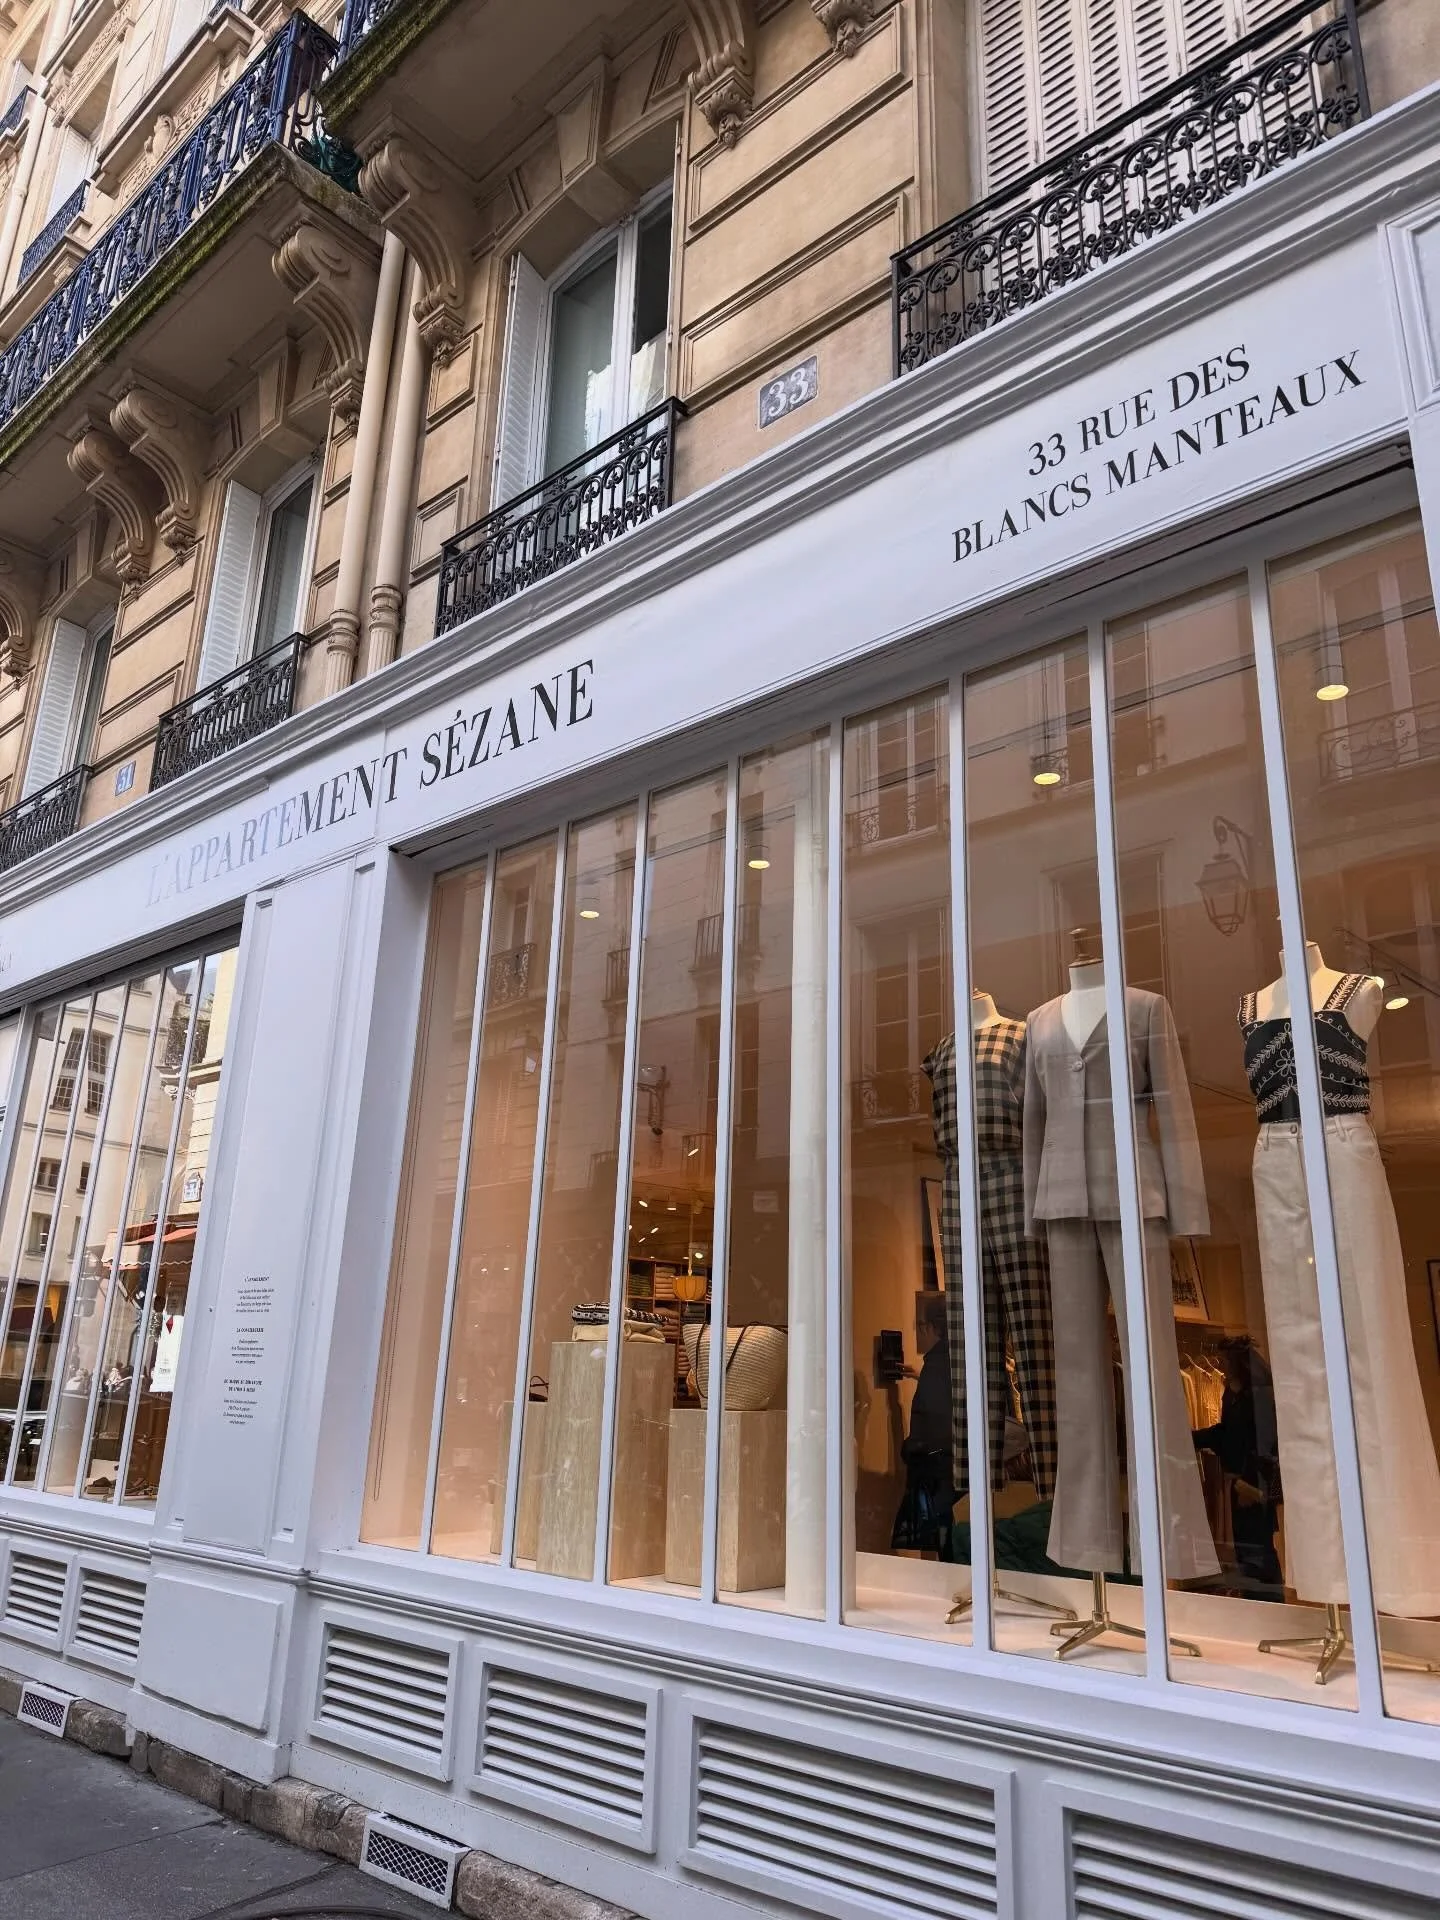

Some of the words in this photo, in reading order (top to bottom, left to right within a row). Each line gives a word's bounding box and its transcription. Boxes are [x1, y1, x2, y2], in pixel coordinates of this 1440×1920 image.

[768, 367, 809, 417] 33
[951, 472, 1092, 563] BLANCS
[1103, 349, 1367, 496] MANTEAUX
[1028, 432, 1067, 476] 33
[1077, 388, 1156, 454] RUE
[1168, 343, 1251, 413] DES
[145, 747, 408, 907] L'APPARTEMENT
[419, 658, 594, 790] SÉZANE
